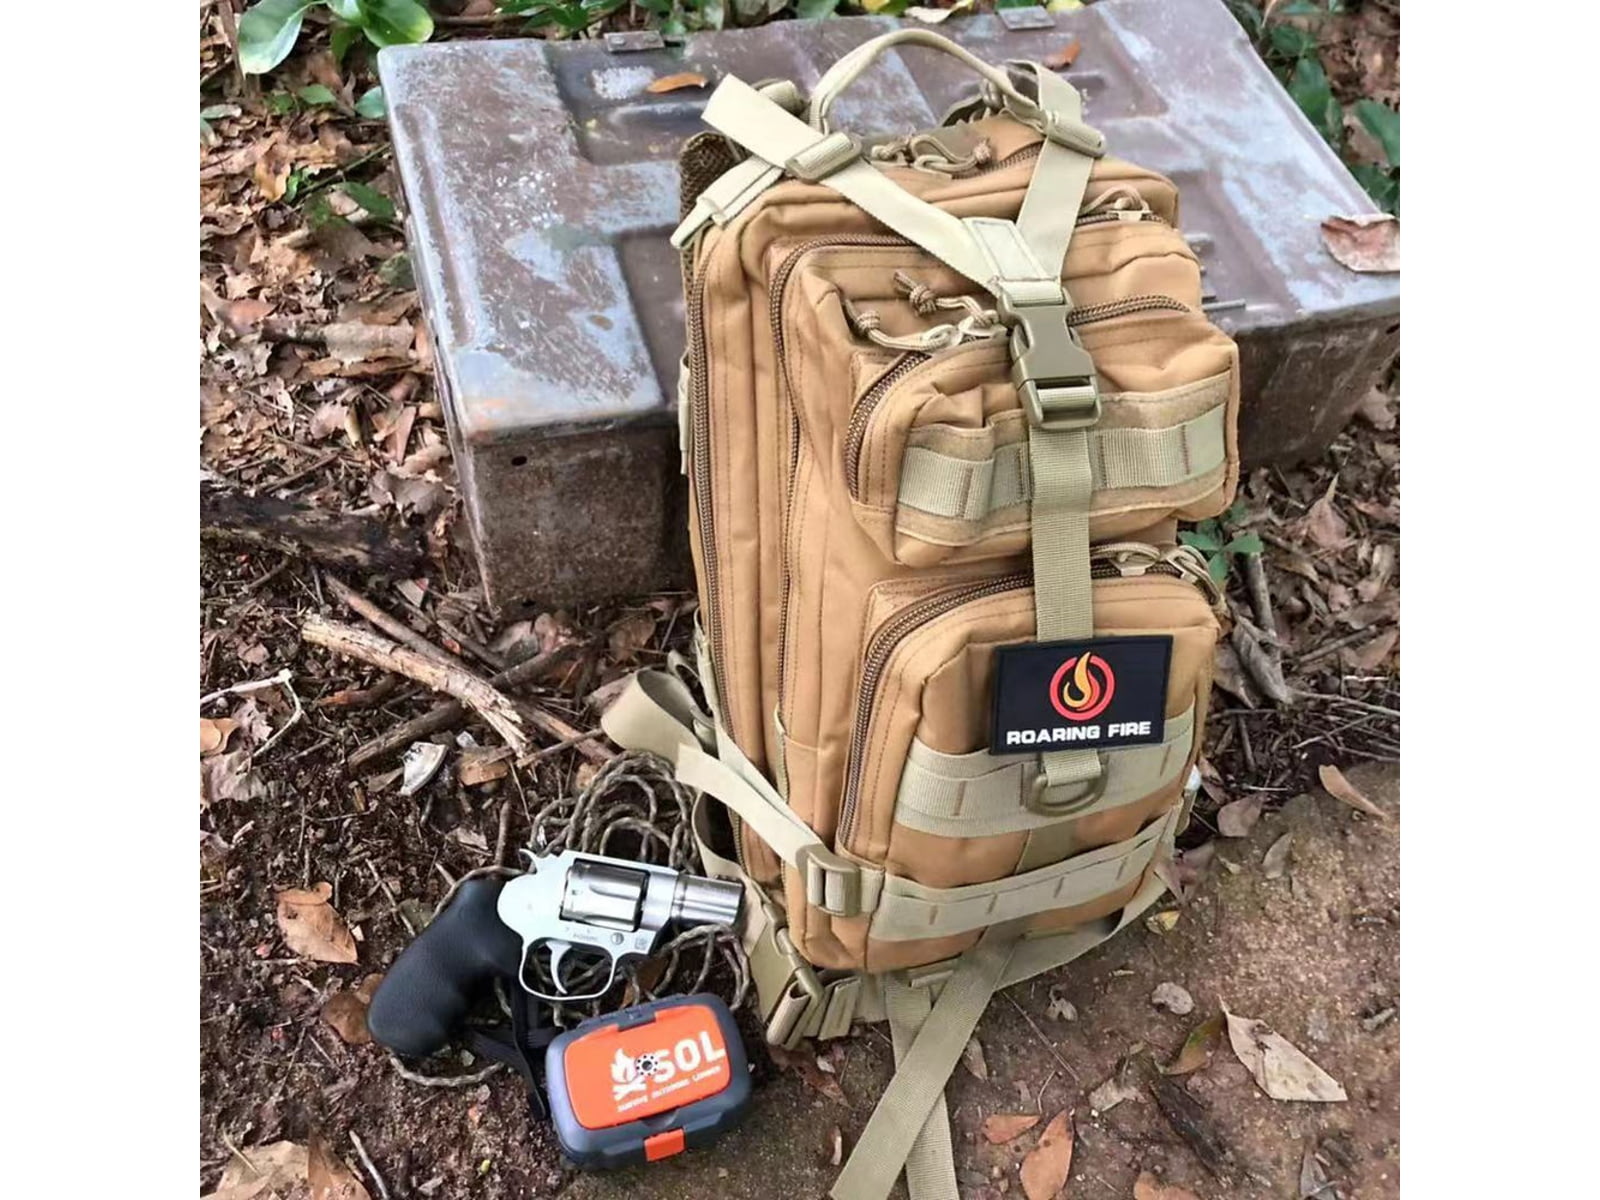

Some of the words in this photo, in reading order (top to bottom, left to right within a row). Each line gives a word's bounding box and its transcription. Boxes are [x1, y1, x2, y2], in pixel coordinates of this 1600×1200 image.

[1006, 725, 1100, 745] ROARING
[1108, 721, 1151, 738] FIRE
[652, 1030, 726, 1083] SOL
